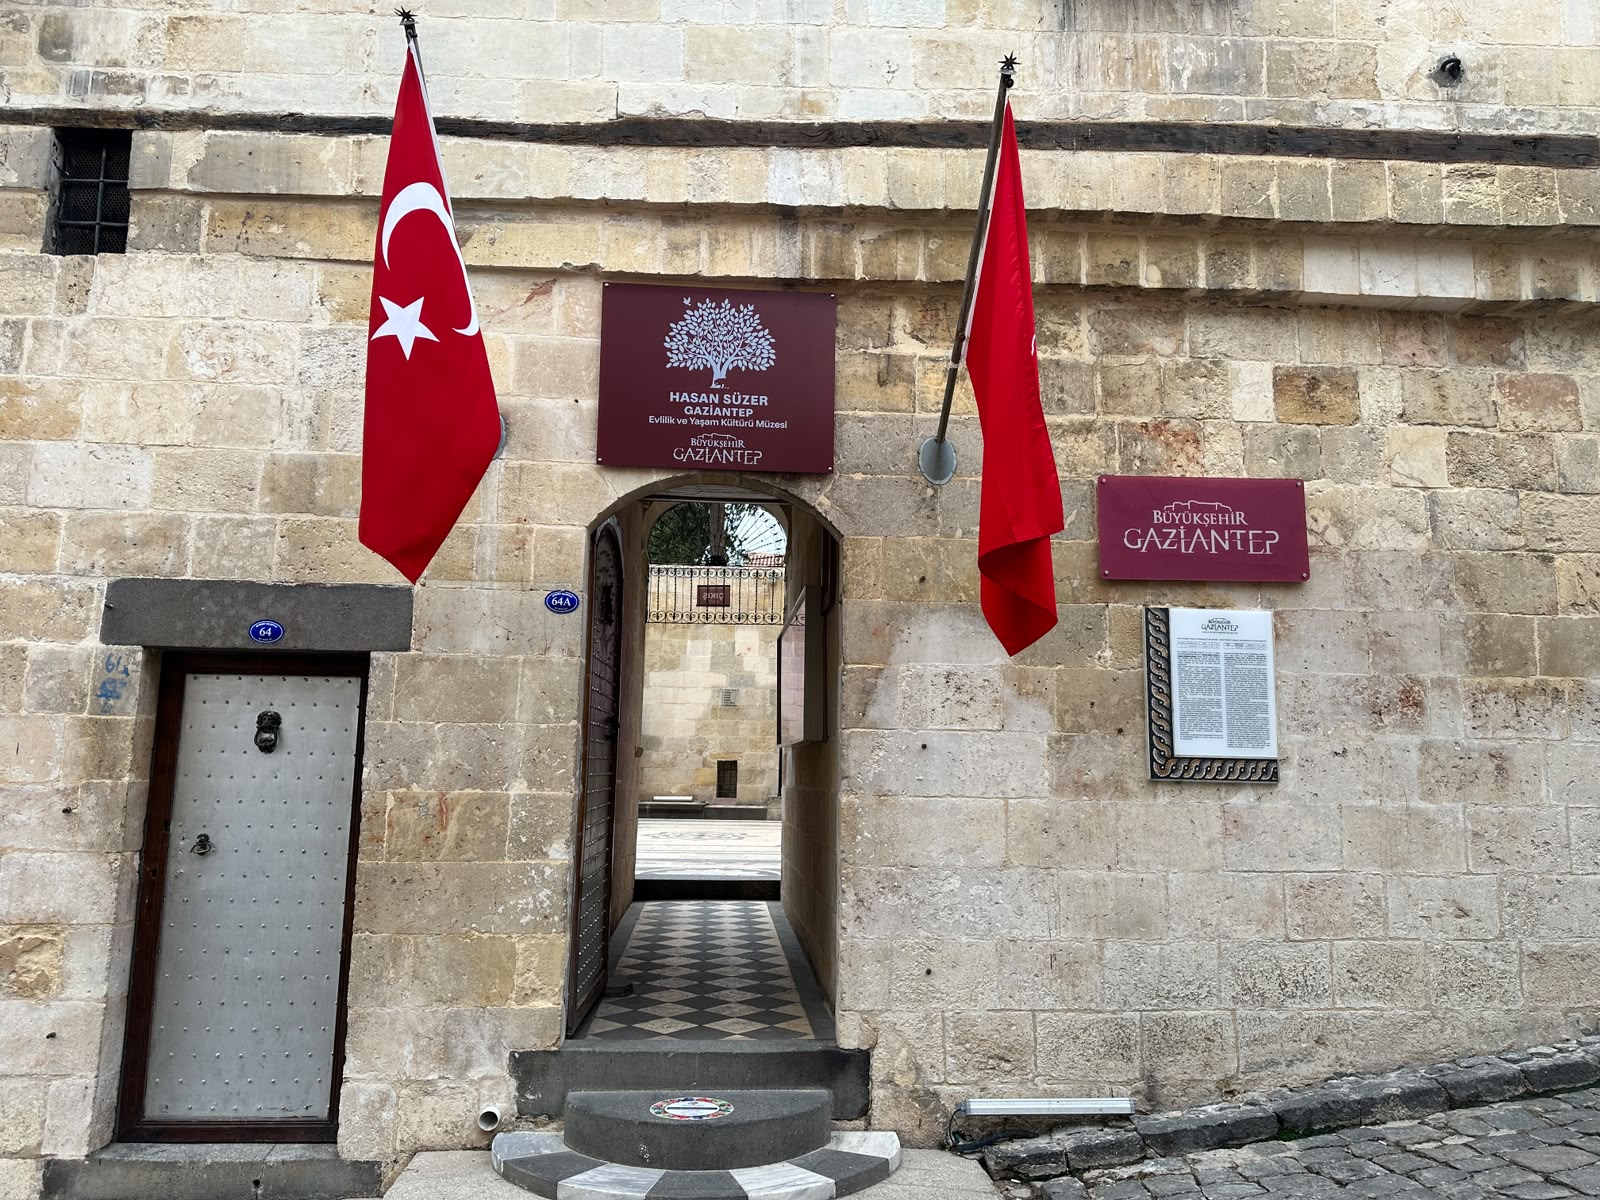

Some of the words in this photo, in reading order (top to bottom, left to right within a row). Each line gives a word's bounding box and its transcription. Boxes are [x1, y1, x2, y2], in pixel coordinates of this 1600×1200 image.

[670, 392, 719, 404] HASAN
[723, 392, 768, 406] SÜZER
[684, 405, 754, 417] GAZİANTEP
[649, 416, 675, 424] Evlilik
[690, 418, 719, 428] Yaşam
[721, 418, 754, 427] Kültürü
[756, 420, 788, 429] Müzesi
[673, 447, 762, 464] GAZİANTEP
[1152, 510, 1248, 527] BÜYÜKŞEHİR
[1123, 525, 1280, 555] GAZİANTEP
[551, 597, 571, 606] 64A
[259, 627, 272, 636] 64
